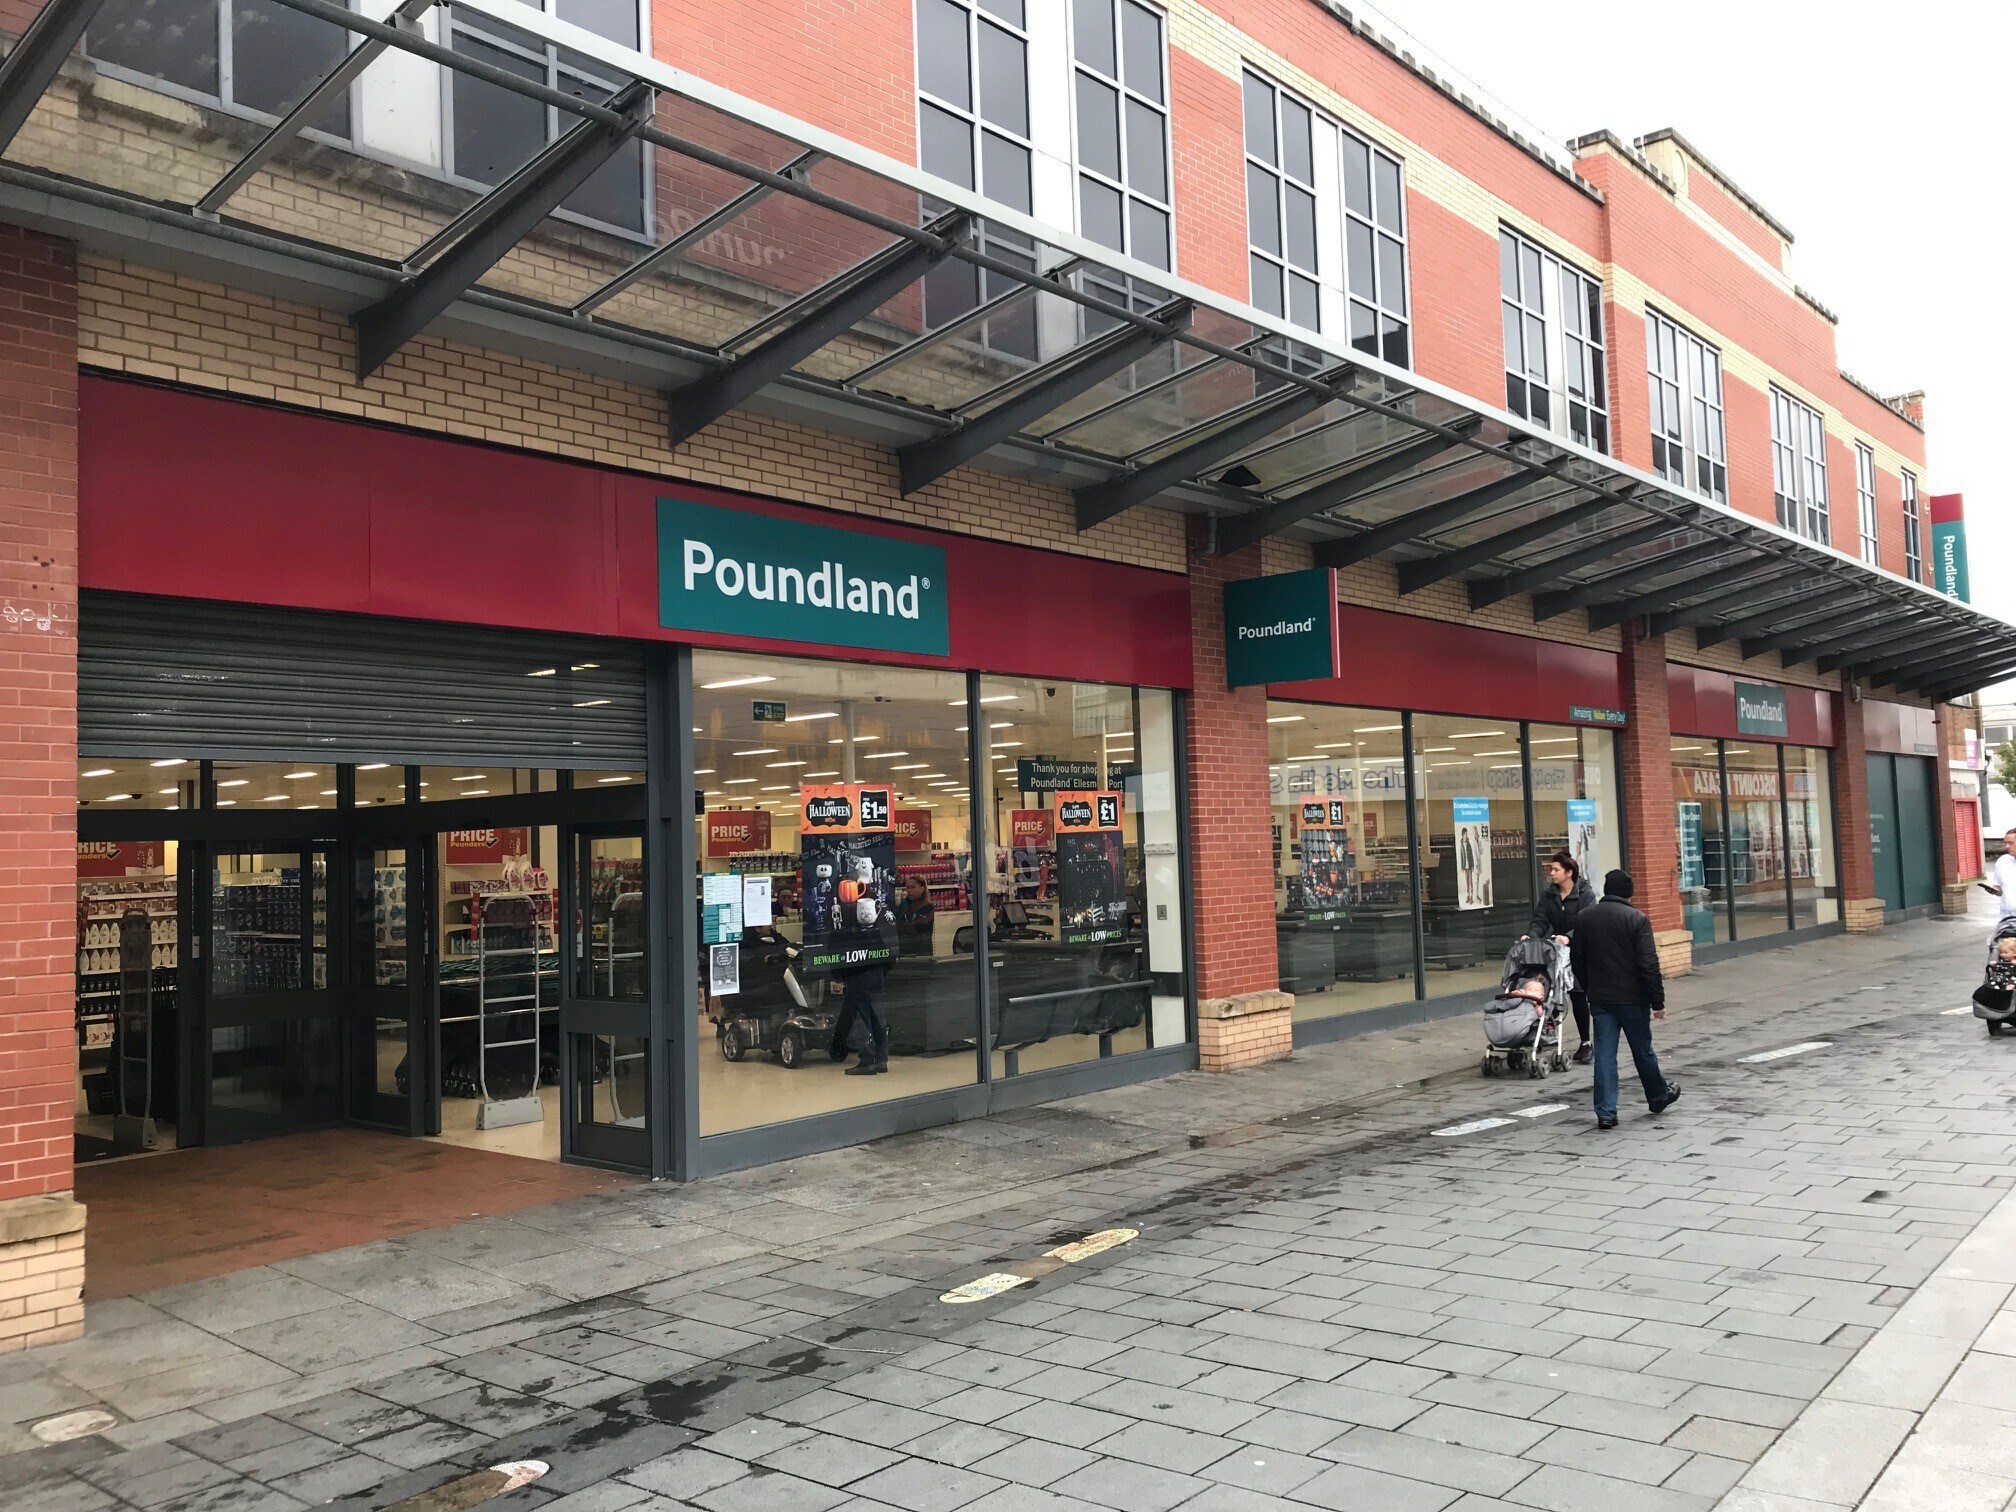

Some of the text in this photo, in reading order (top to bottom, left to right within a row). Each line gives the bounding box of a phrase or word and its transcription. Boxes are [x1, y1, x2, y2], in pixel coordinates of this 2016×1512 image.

[1943, 535, 1959, 598] Poundland
[1740, 697, 1783, 722] Poundland
[1031, 762, 1122, 776] Thank you for shopg at
[1108, 779, 1123, 789] Port
[809, 804, 851, 819] HALLOWEEN
[861, 801, 887, 819] £1.50
[1062, 806, 1092, 819] HALLOWEEN
[1100, 802, 1115, 821] £1
[1331, 805, 1342, 820] £1
[711, 825, 749, 838] PRICE
[894, 822, 916, 833] RICE
[1014, 820, 1043, 831] PRICE
[450, 829, 495, 842] PRICE
[78, 841, 116, 854] RICE
[1324, 911, 1336, 920] LOW
[1068, 933, 1087, 943] BEWARE
[1091, 930, 1107, 942] LOW
[1106, 929, 1122, 938] PRICES
[813, 953, 840, 965] BEWARE
[845, 949, 869, 964] LOW
[868, 949, 890, 959] PRICES
